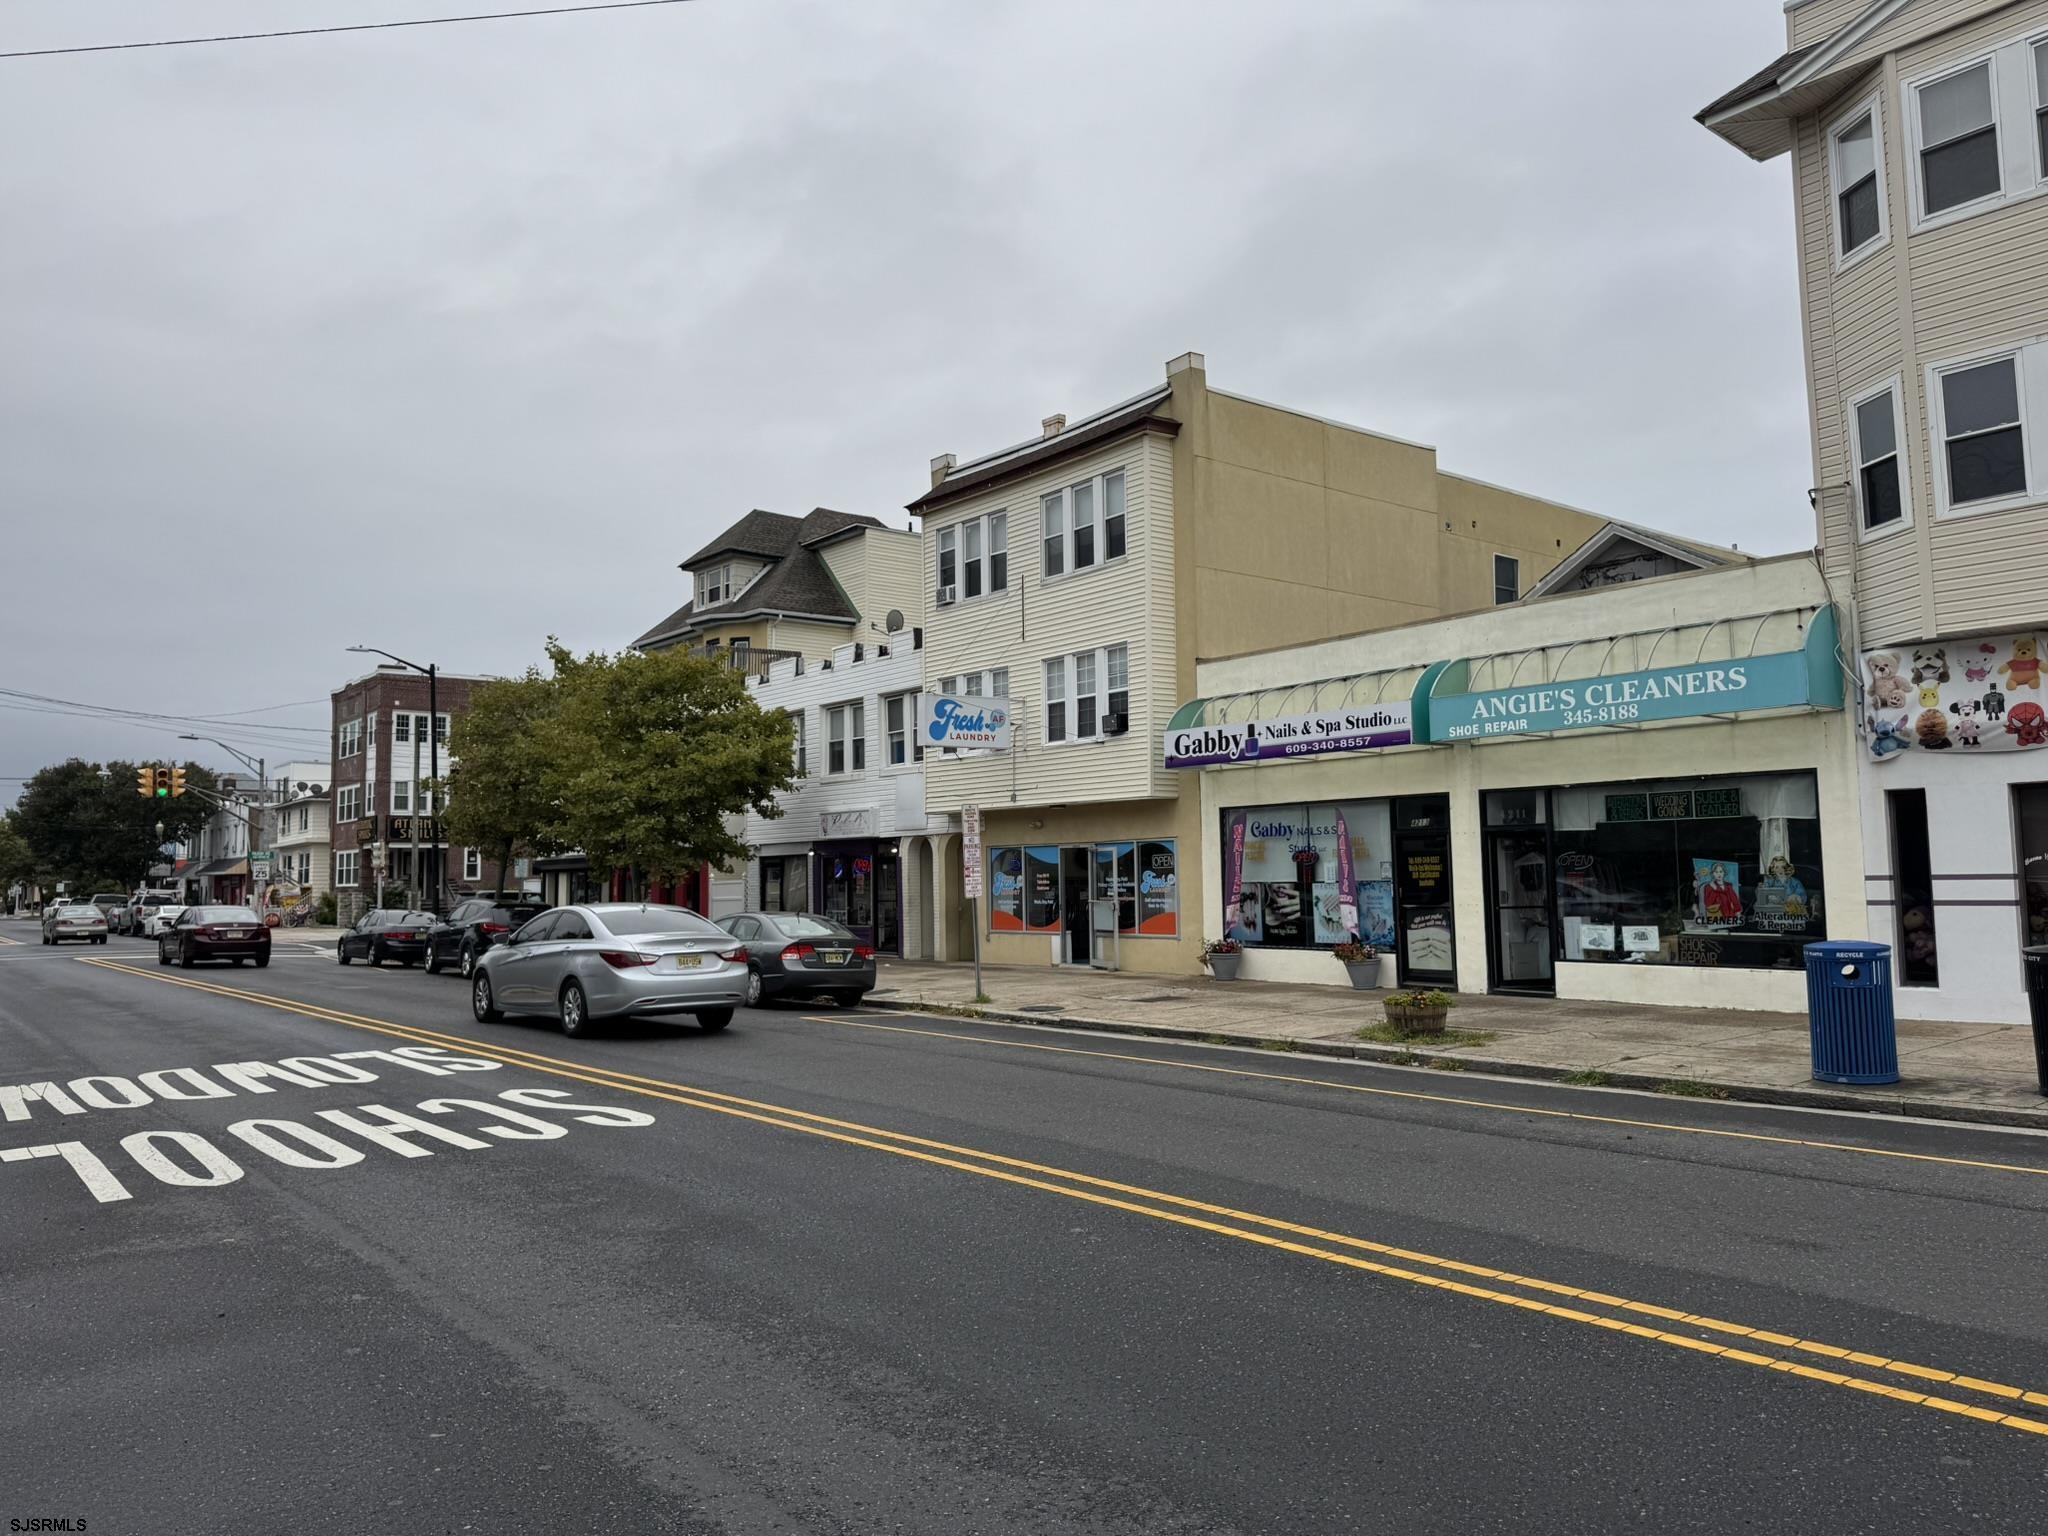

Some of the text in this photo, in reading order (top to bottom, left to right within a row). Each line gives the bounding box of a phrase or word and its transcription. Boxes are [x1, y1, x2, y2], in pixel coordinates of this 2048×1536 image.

[1472, 666, 1748, 719] ANGIE'S CLEANERS
[929, 698, 984, 741] Fresh
[992, 715, 1004, 723] AF
[1563, 704, 1639, 726] 345-8188
[1174, 711, 1408, 758] Gabby Nails & Spa Studio LLC
[1449, 719, 1528, 737] SHOE REPAIR
[950, 733, 996, 742] LAUNDRY
[1285, 736, 1371, 754] 609-340-8557
[1654, 795, 1688, 807] WEDDING
[1696, 791, 1729, 804] SUEDE
[1657, 805, 1686, 818] GOWNS
[1697, 804, 1739, 817] LEATHER
[1251, 821, 1295, 841] Gabby
[1153, 856, 1174, 868] OPEN
[1561, 854, 1590, 867] OPEN
[255, 870, 268, 878] 25
[1695, 915, 1746, 927] CLEANERS
[1754, 911, 1809, 922] Alterations
[1758, 920, 1806, 933] & Repairs
[1680, 938, 1705, 950] SHOE
[1681, 951, 1718, 964] REPAIR
[0, 1088, 655, 1203] SCHOOL
